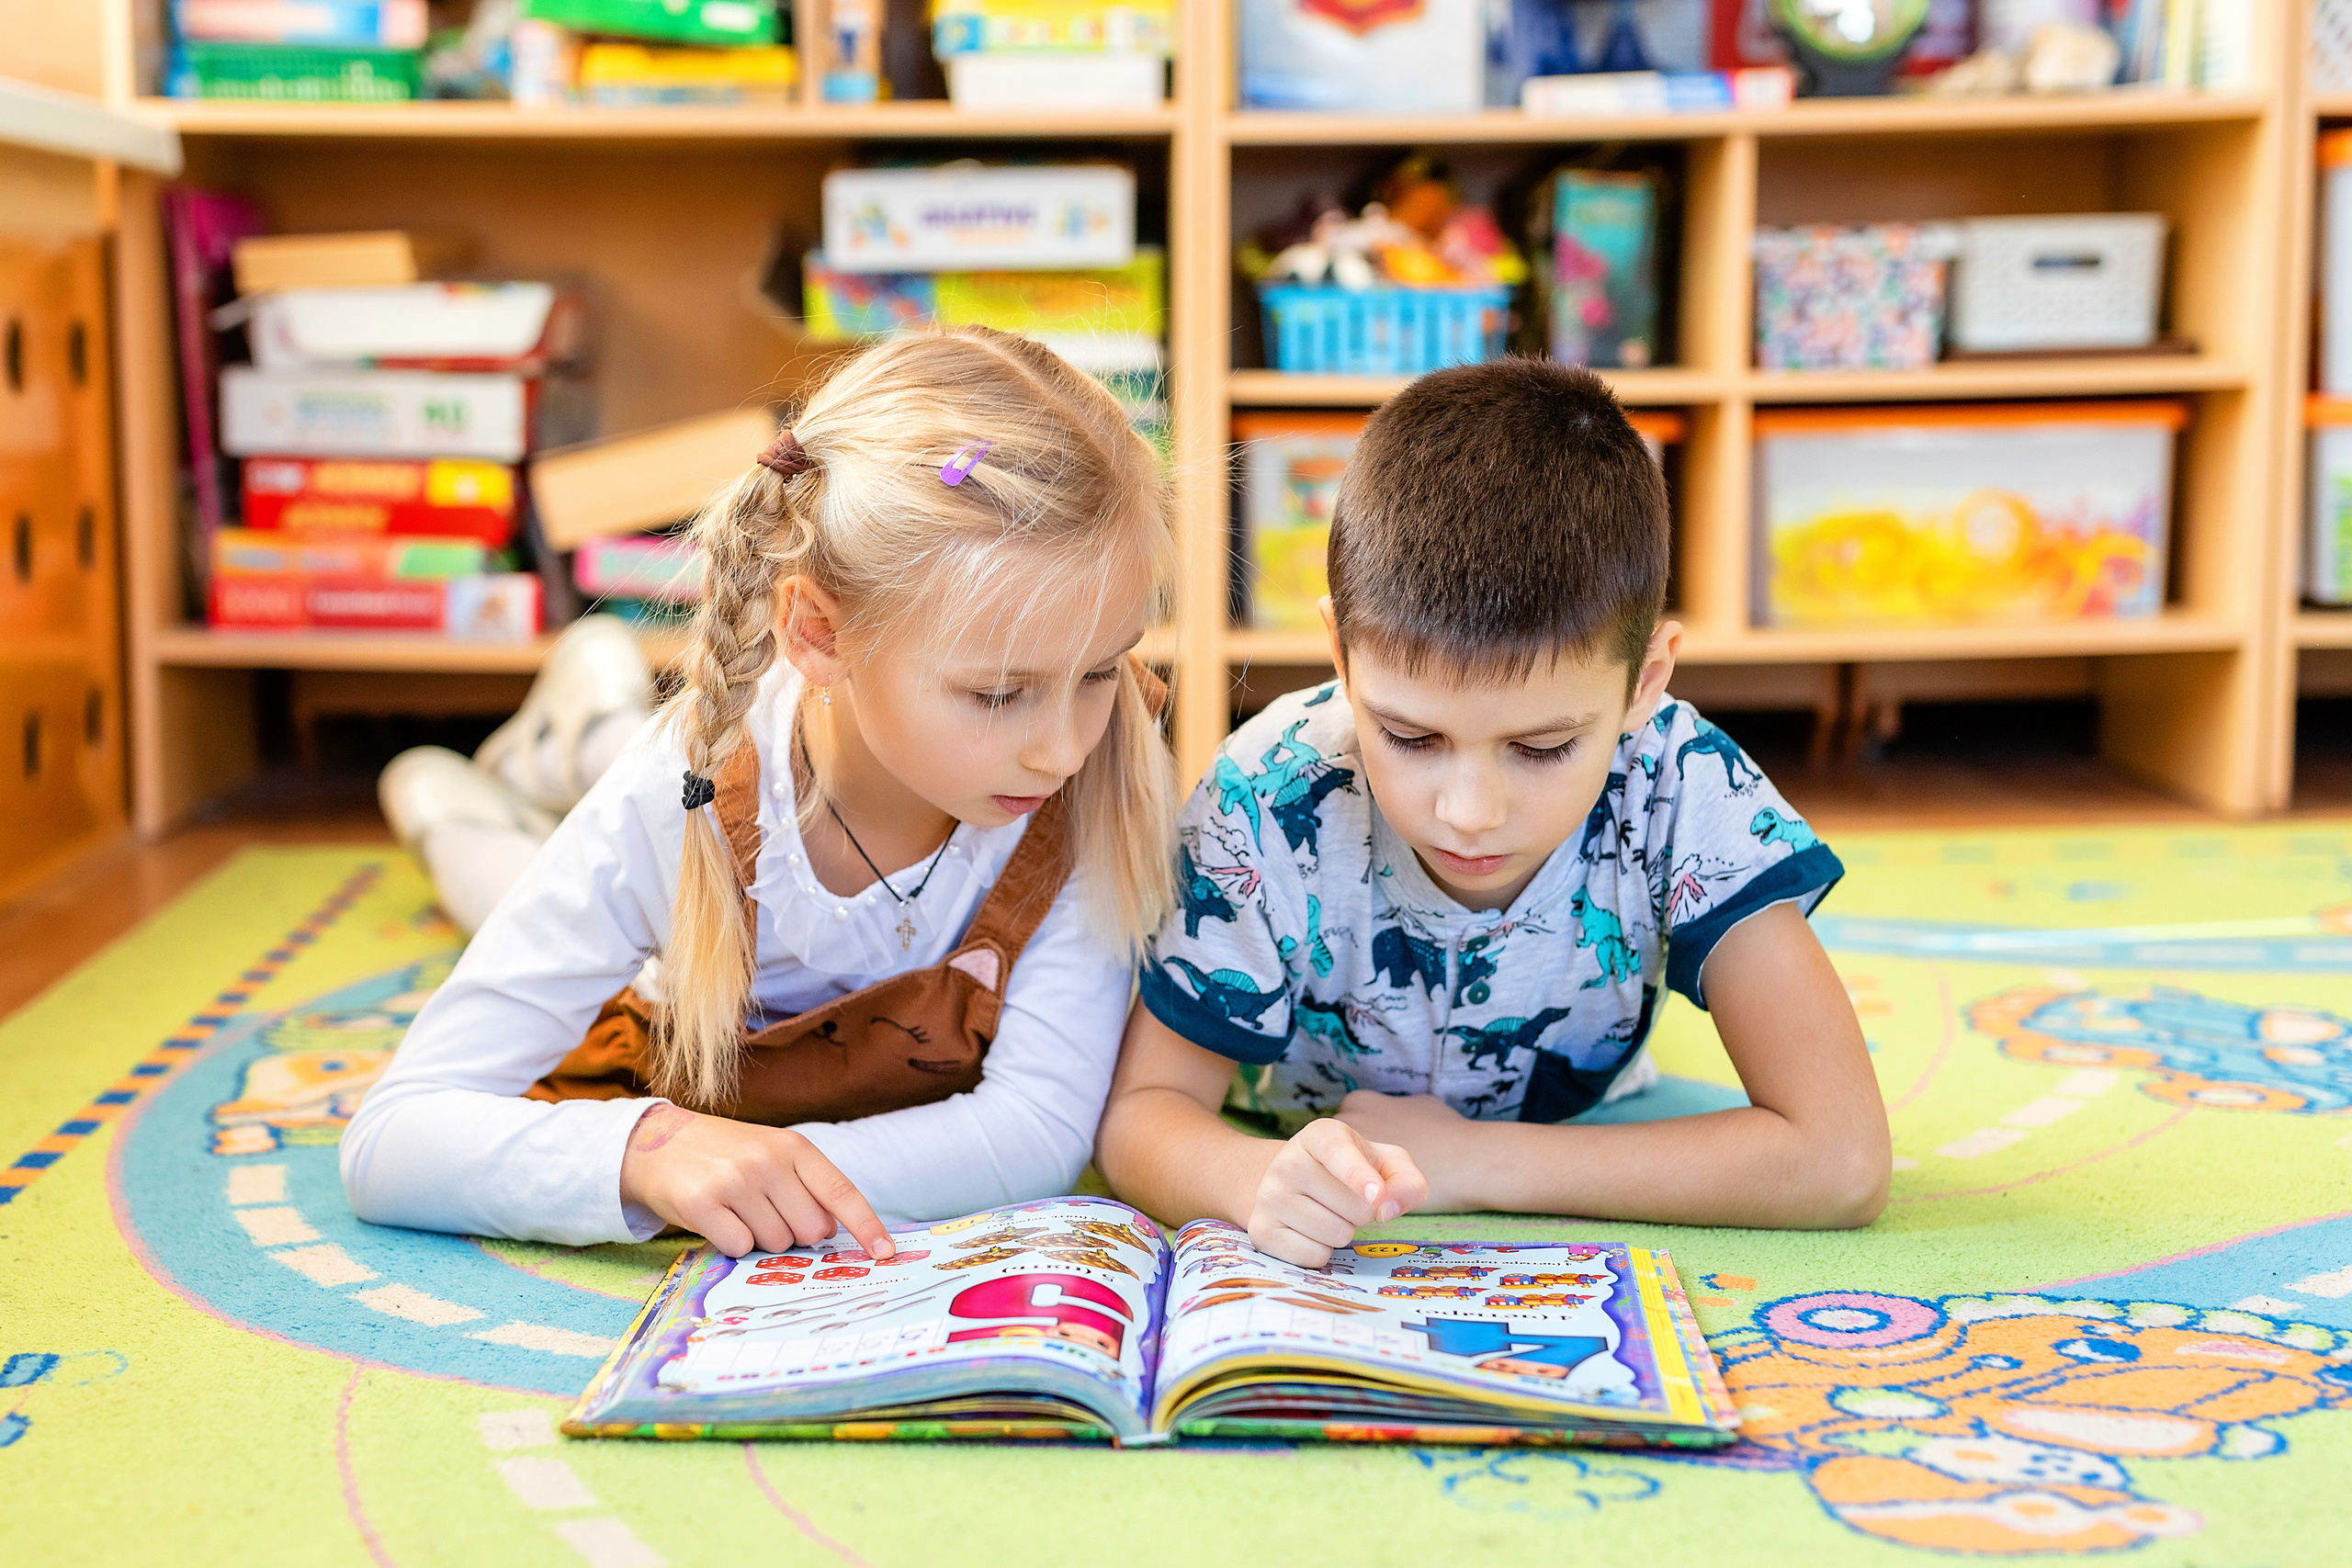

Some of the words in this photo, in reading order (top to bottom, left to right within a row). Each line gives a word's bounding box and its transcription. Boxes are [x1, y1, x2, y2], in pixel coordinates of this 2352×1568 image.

[1001, 1264, 1091, 1275] (пять)
[1102, 1273, 1115, 1283] 5
[1415, 1309, 1548, 1321] (четыре)
